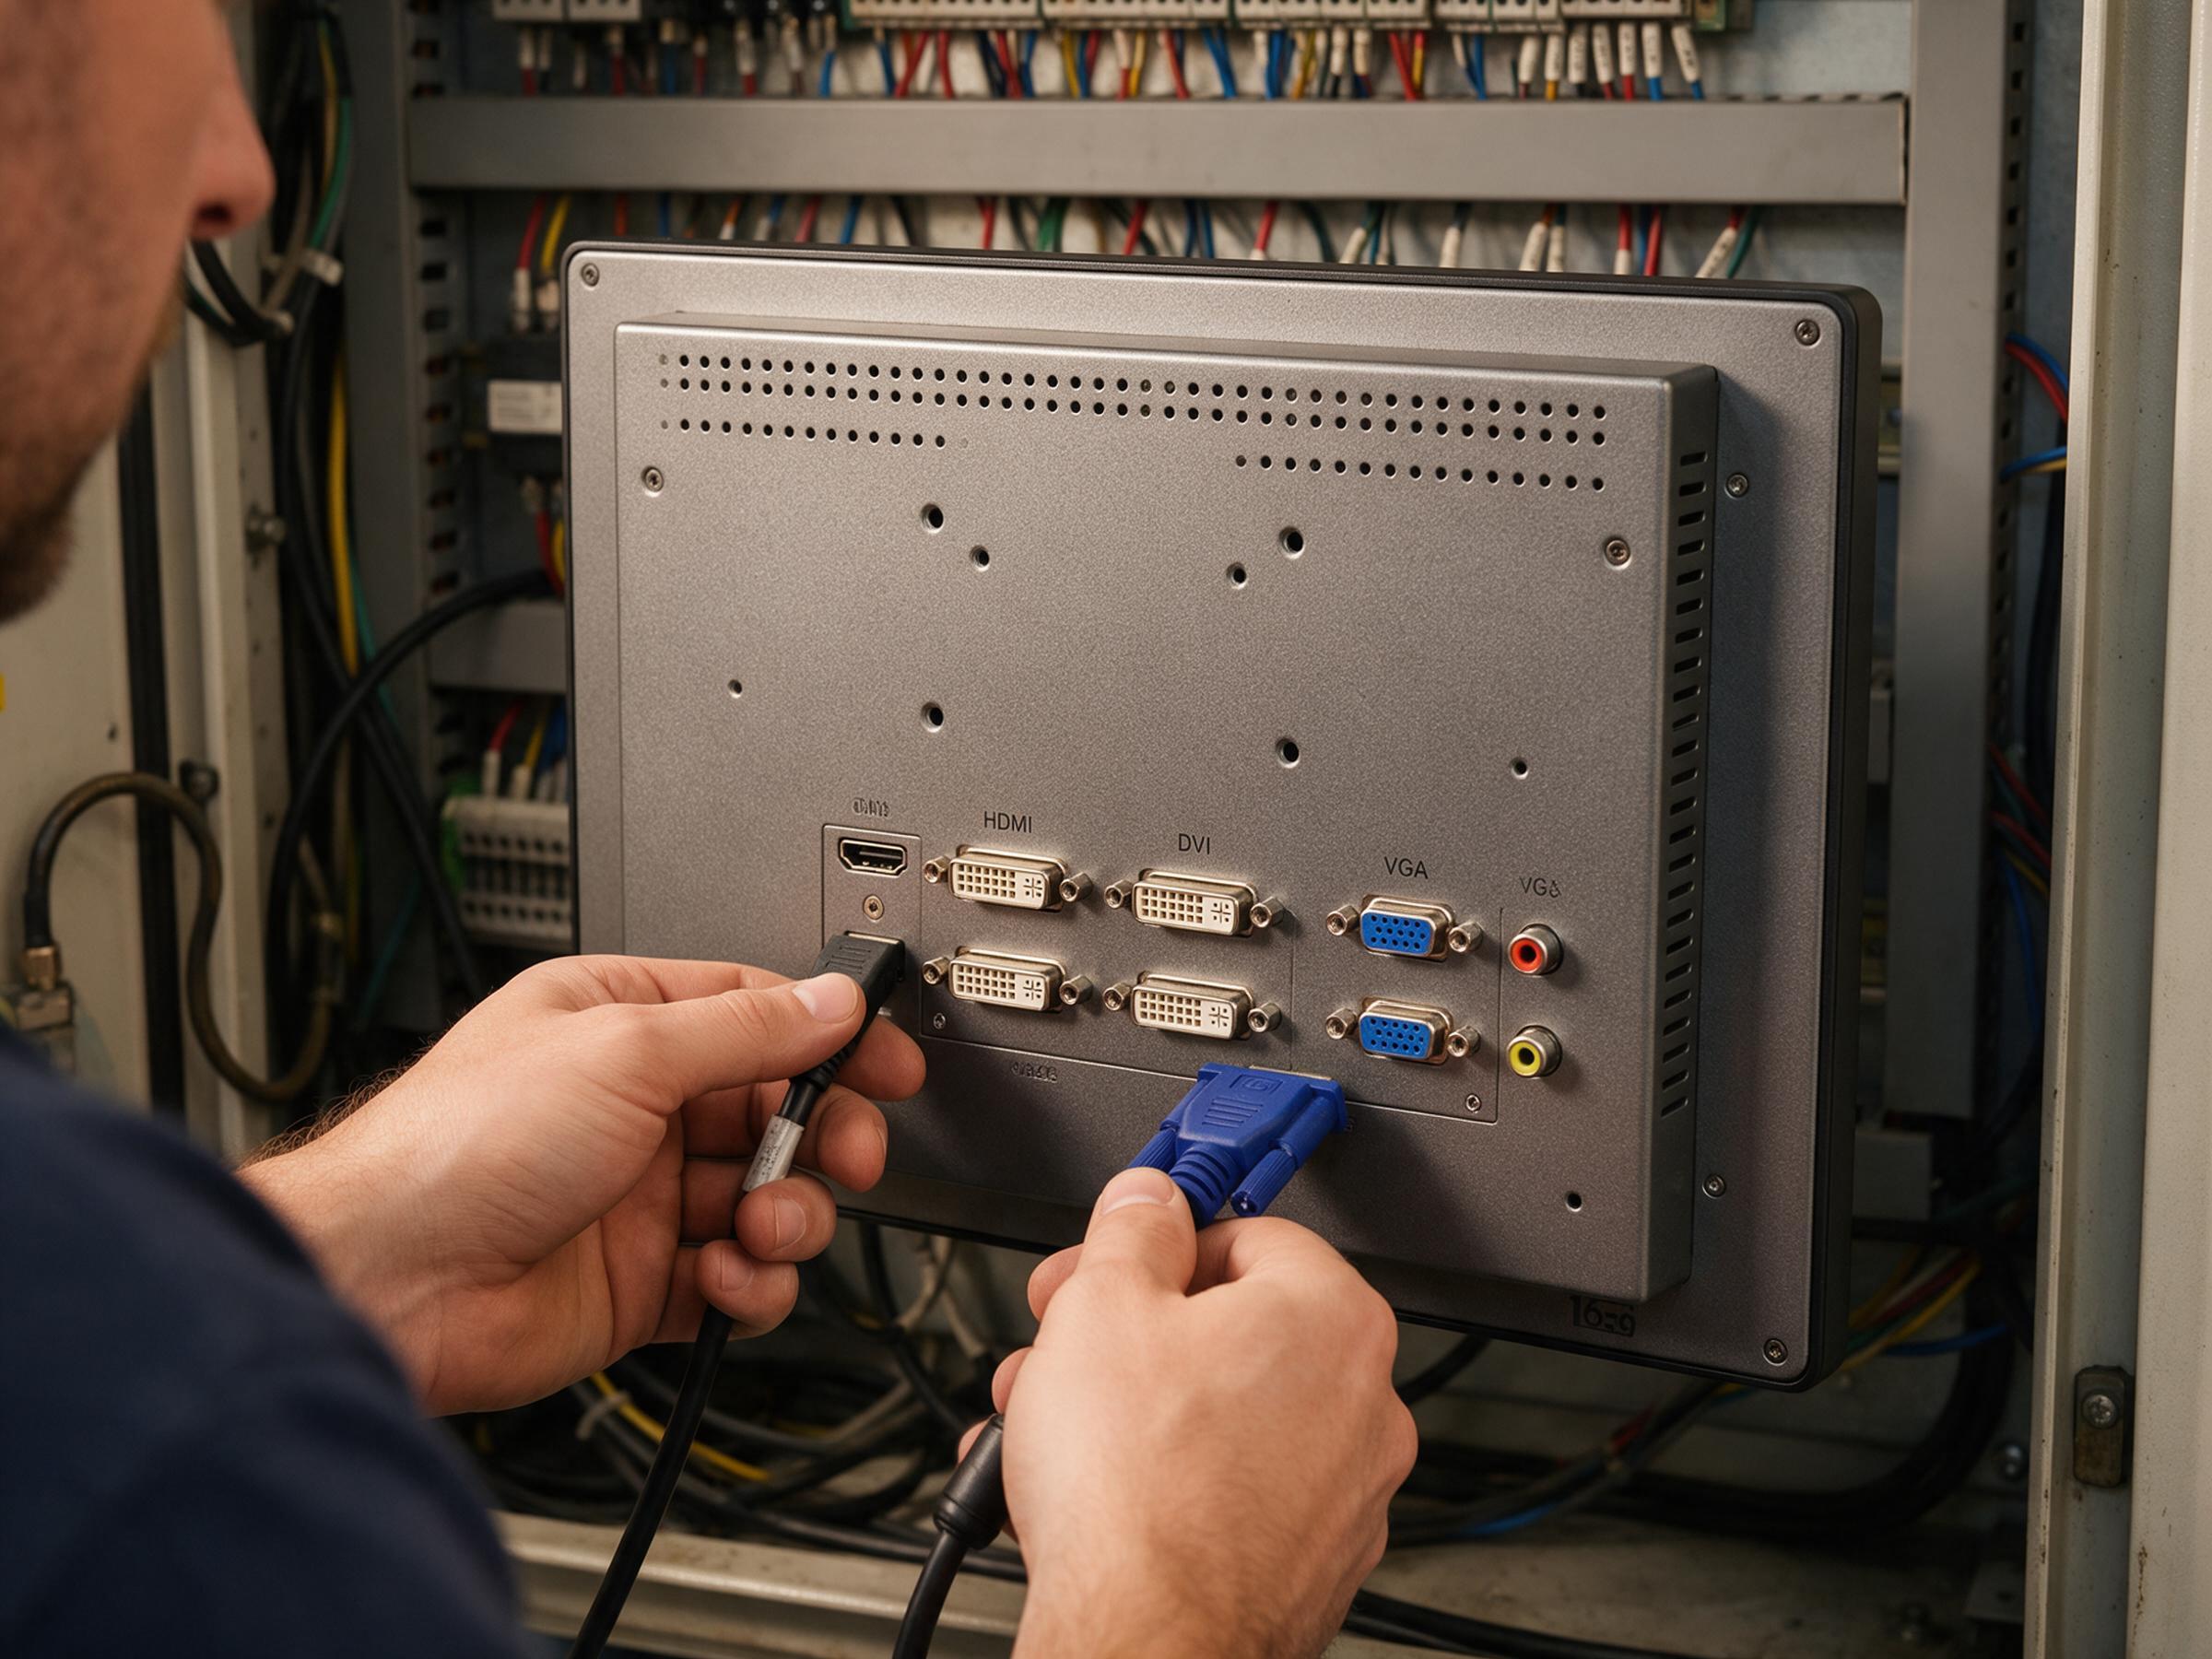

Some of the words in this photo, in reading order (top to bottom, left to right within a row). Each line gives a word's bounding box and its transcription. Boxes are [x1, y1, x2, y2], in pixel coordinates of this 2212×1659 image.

[984, 811, 1032, 833] HDMI
[1178, 833, 1210, 854] DVI
[1384, 857, 1428, 879] VGA
